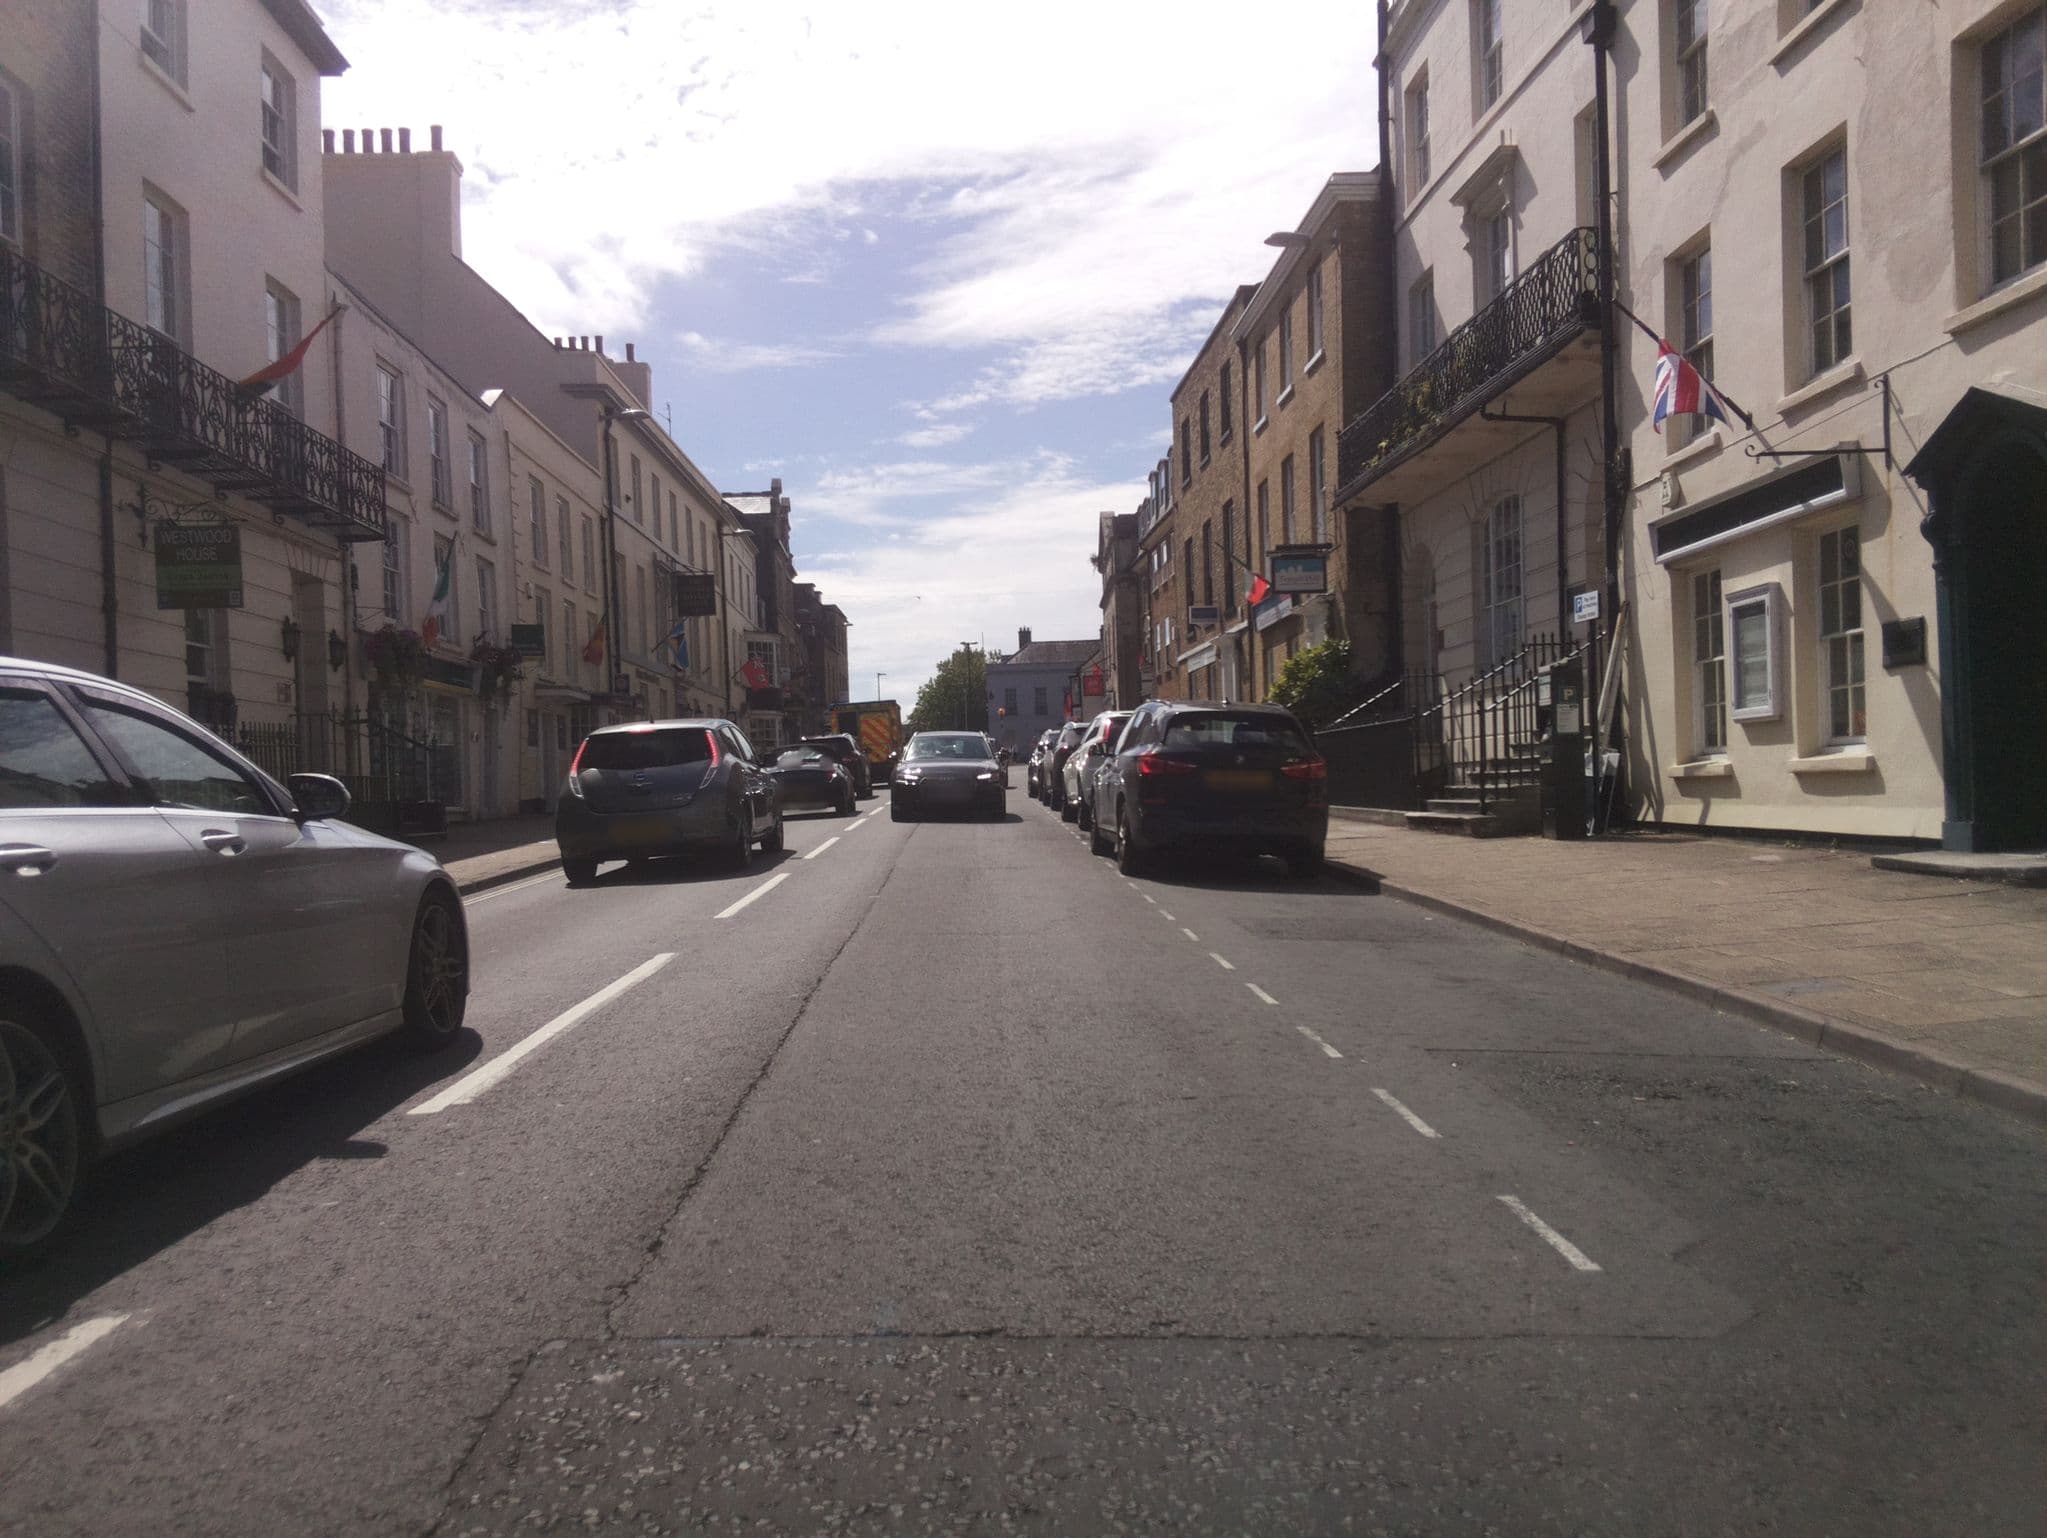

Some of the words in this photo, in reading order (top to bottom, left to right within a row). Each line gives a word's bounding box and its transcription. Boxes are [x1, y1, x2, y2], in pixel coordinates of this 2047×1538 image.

[159, 528, 232, 544] WESTWOOD
[176, 545, 218, 561] HOUSE
[1563, 688, 1574, 701] P
